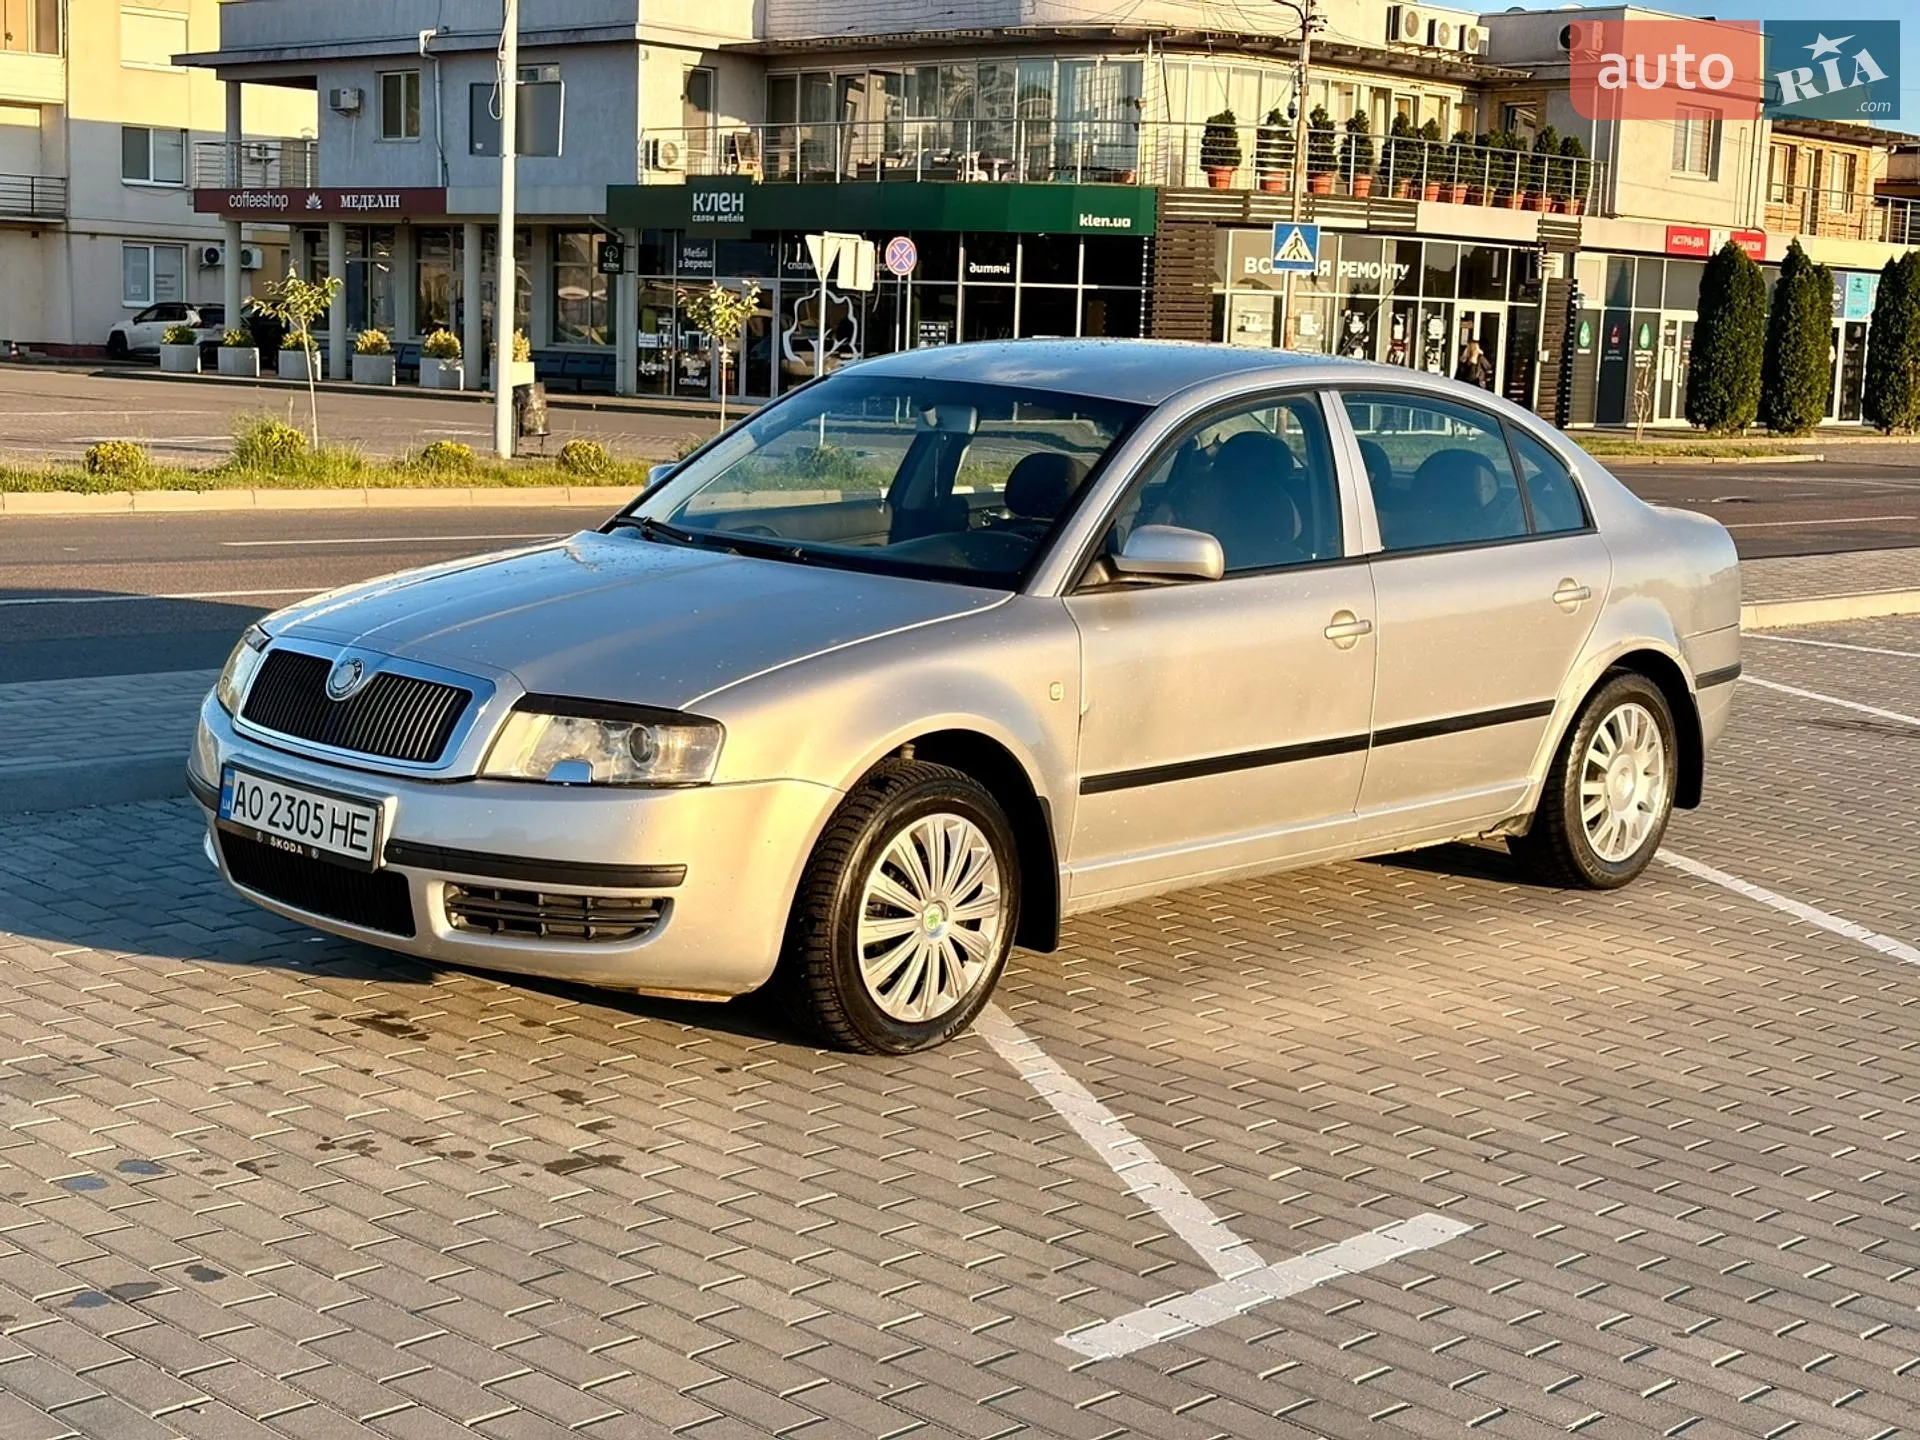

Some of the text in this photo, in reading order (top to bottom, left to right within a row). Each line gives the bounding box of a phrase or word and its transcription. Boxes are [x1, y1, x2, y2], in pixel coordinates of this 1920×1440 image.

[229, 191, 289, 211] coffeeshop
[340, 194, 400, 211] МЕДЕЛІН
[1079, 213, 1131, 228] klen.ua
[969, 262, 1011, 274] дитячі
[1339, 261, 1410, 280] РЕМОНТУ
[233, 781, 370, 853] AO 2305 HE
